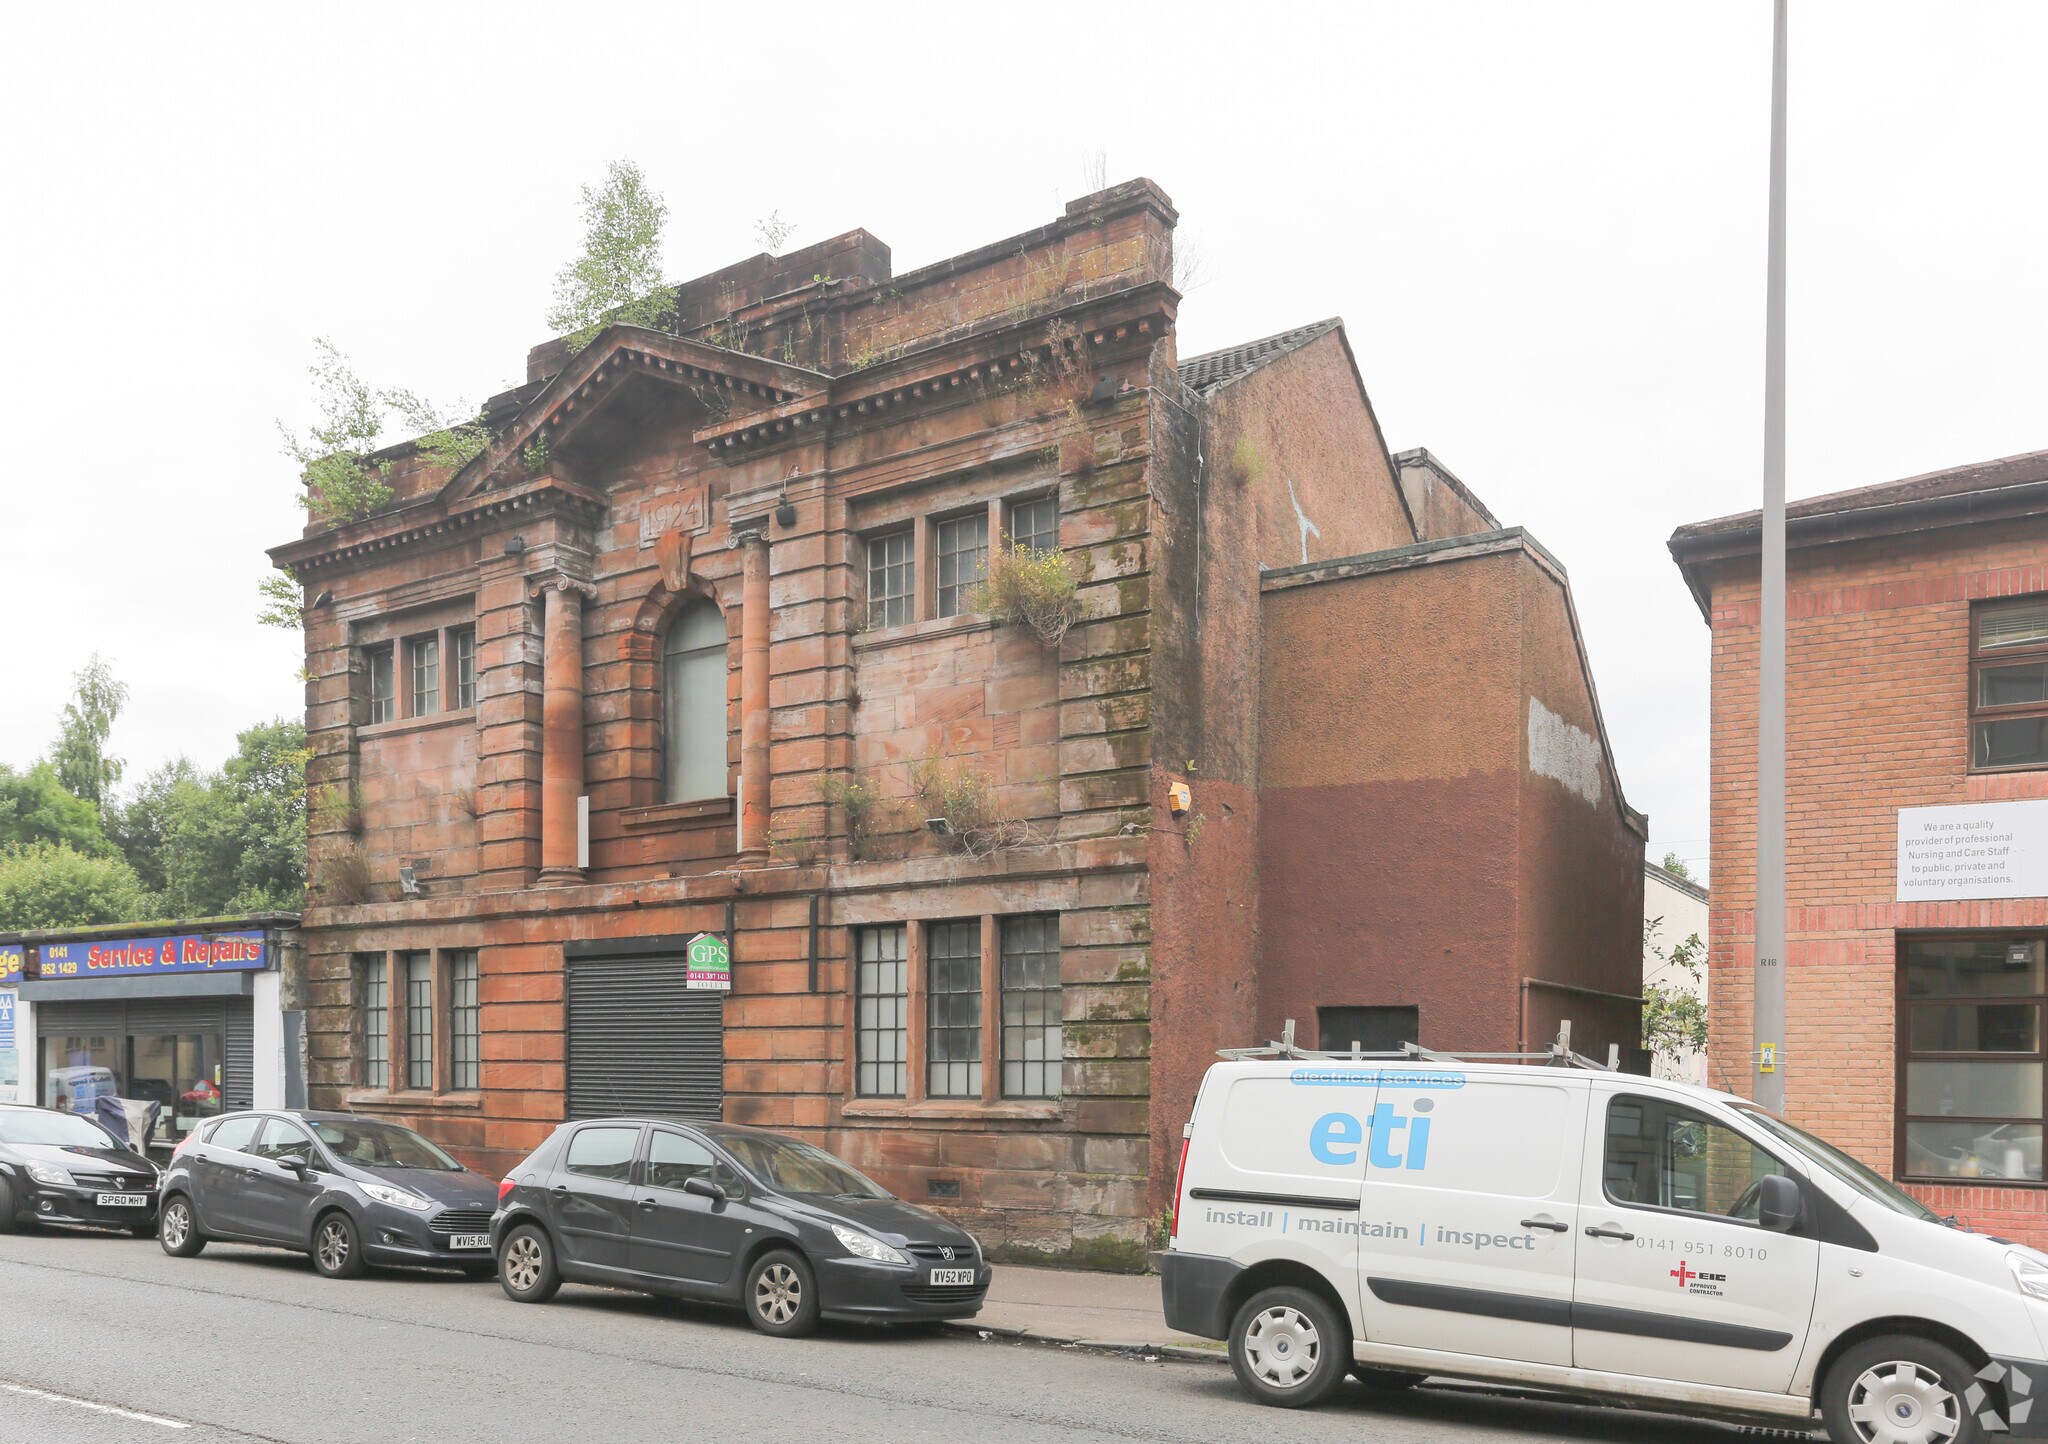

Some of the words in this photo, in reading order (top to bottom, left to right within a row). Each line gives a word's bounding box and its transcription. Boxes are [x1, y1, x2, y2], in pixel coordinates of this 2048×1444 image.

[647, 497, 698, 536] 1924
[1923, 823, 1938, 831] We
[1940, 823, 1954, 831] are
[1963, 820, 1994, 831] quality
[1905, 837, 1943, 848] provider
[1944, 836, 1954, 845] of
[1955, 833, 2013, 845] professional
[1908, 850, 1944, 860] Nursing
[1945, 849, 1963, 858] and
[1964, 848, 1985, 857] Care
[1987, 847, 2010, 856] Staff
[1911, 865, 1920, 873] to
[1922, 863, 1953, 874] public,
[1954, 862, 1986, 872] private
[1987, 861, 2005, 870] and
[1903, 877, 1946, 887] voluntary
[1947, 875, 2014, 887] organisations.
[49, 946, 68, 958] 0141
[87, 941, 156, 970] Service
[160, 940, 176, 966] &
[181, 936, 261, 969] Repairs
[690, 945, 728, 963] GPS
[41, 963, 56, 975] 952
[58, 962, 78, 974] 1429
[1292, 1071, 1378, 1084] electrical
[1382, 1073, 1464, 1086] services
[1309, 1097, 1435, 1170] eti
[101, 1195, 126, 1205] SP60
[128, 1196, 144, 1205] MHY
[1205, 1207, 1273, 1228] install
[1299, 1216, 1409, 1240] maintain
[1436, 1225, 1536, 1251] inspect
[456, 1235, 476, 1246] WV15
[1636, 1237, 1674, 1252] 0141
[1684, 1241, 1714, 1255] 951
[1723, 1245, 1767, 1261] 8010
[934, 1270, 956, 1283] WV52
[1689, 1288, 1724, 1297] CONTRACTOR
[1690, 1282, 1717, 1290] APPROVED
